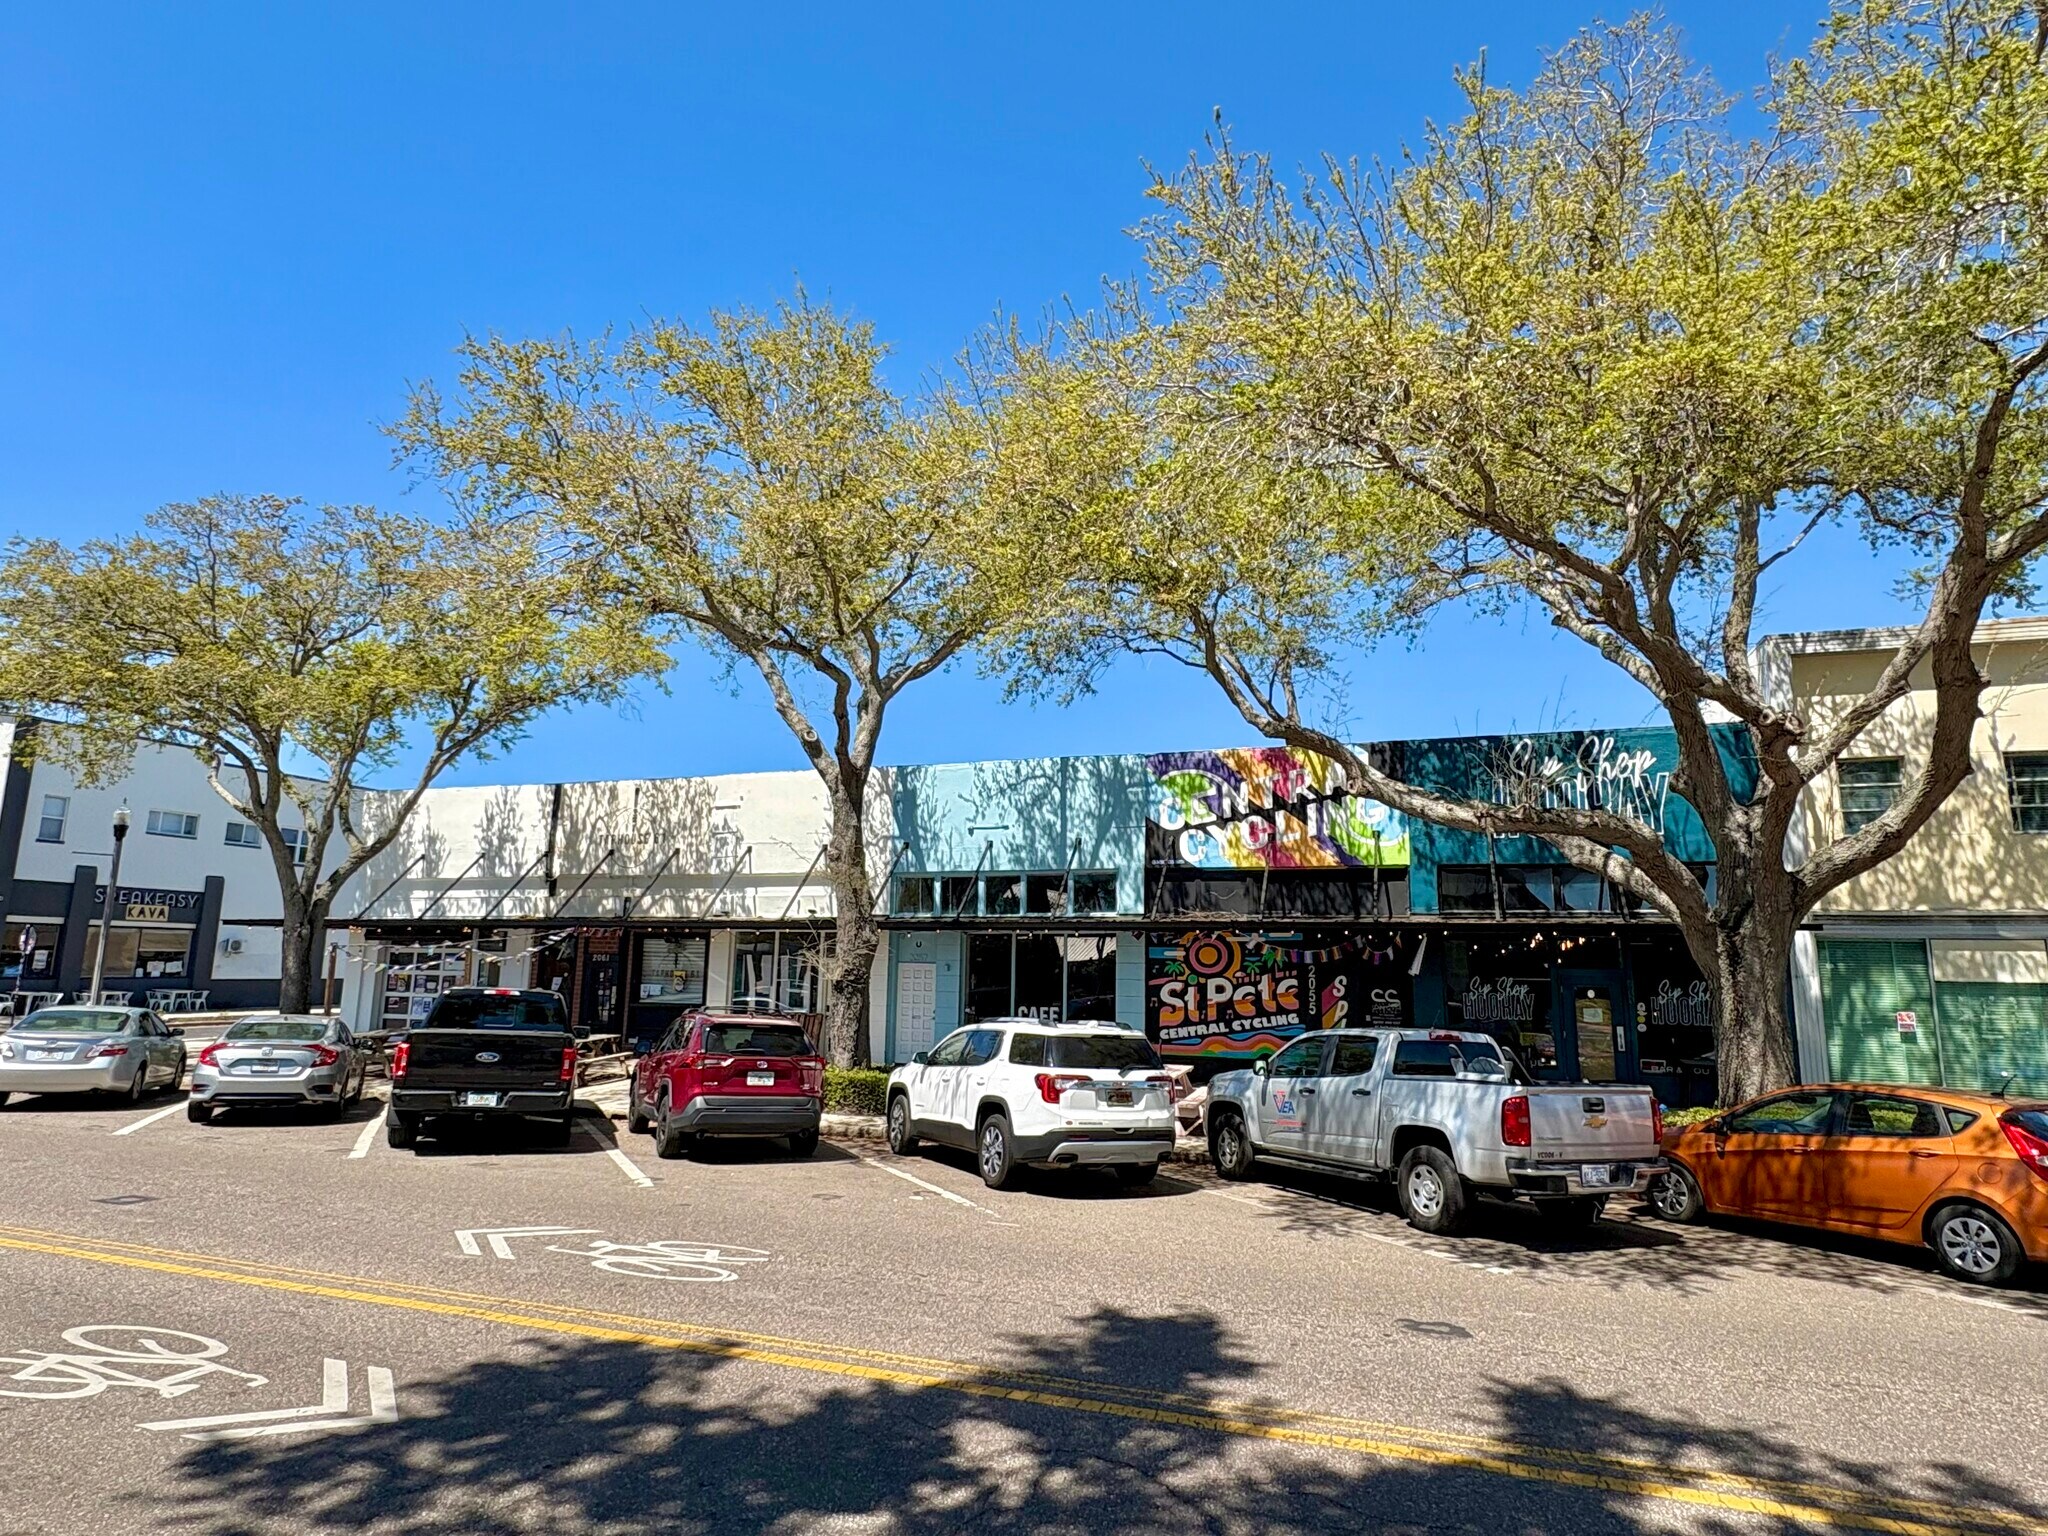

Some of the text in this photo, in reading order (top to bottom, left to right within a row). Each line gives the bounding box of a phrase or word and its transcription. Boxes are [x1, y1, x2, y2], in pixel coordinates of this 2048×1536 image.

[1576, 735, 1657, 790] Shop
[1159, 762, 1347, 831] CENTRA
[1180, 797, 1387, 863] CYCLING
[94, 888, 198, 908] SEAKEASY
[127, 906, 166, 919] KAVA
[1159, 973, 1299, 1028] St Pete
[1308, 965, 1317, 1015] 2055
[1470, 976, 1530, 1000] Sip Shop
[1658, 979, 1711, 1005] Sip Sh
[1463, 992, 1535, 1020] HOORAY
[1650, 996, 1714, 1026] HOOR
[1160, 1013, 1299, 1040] CENTRAL CYCLING
